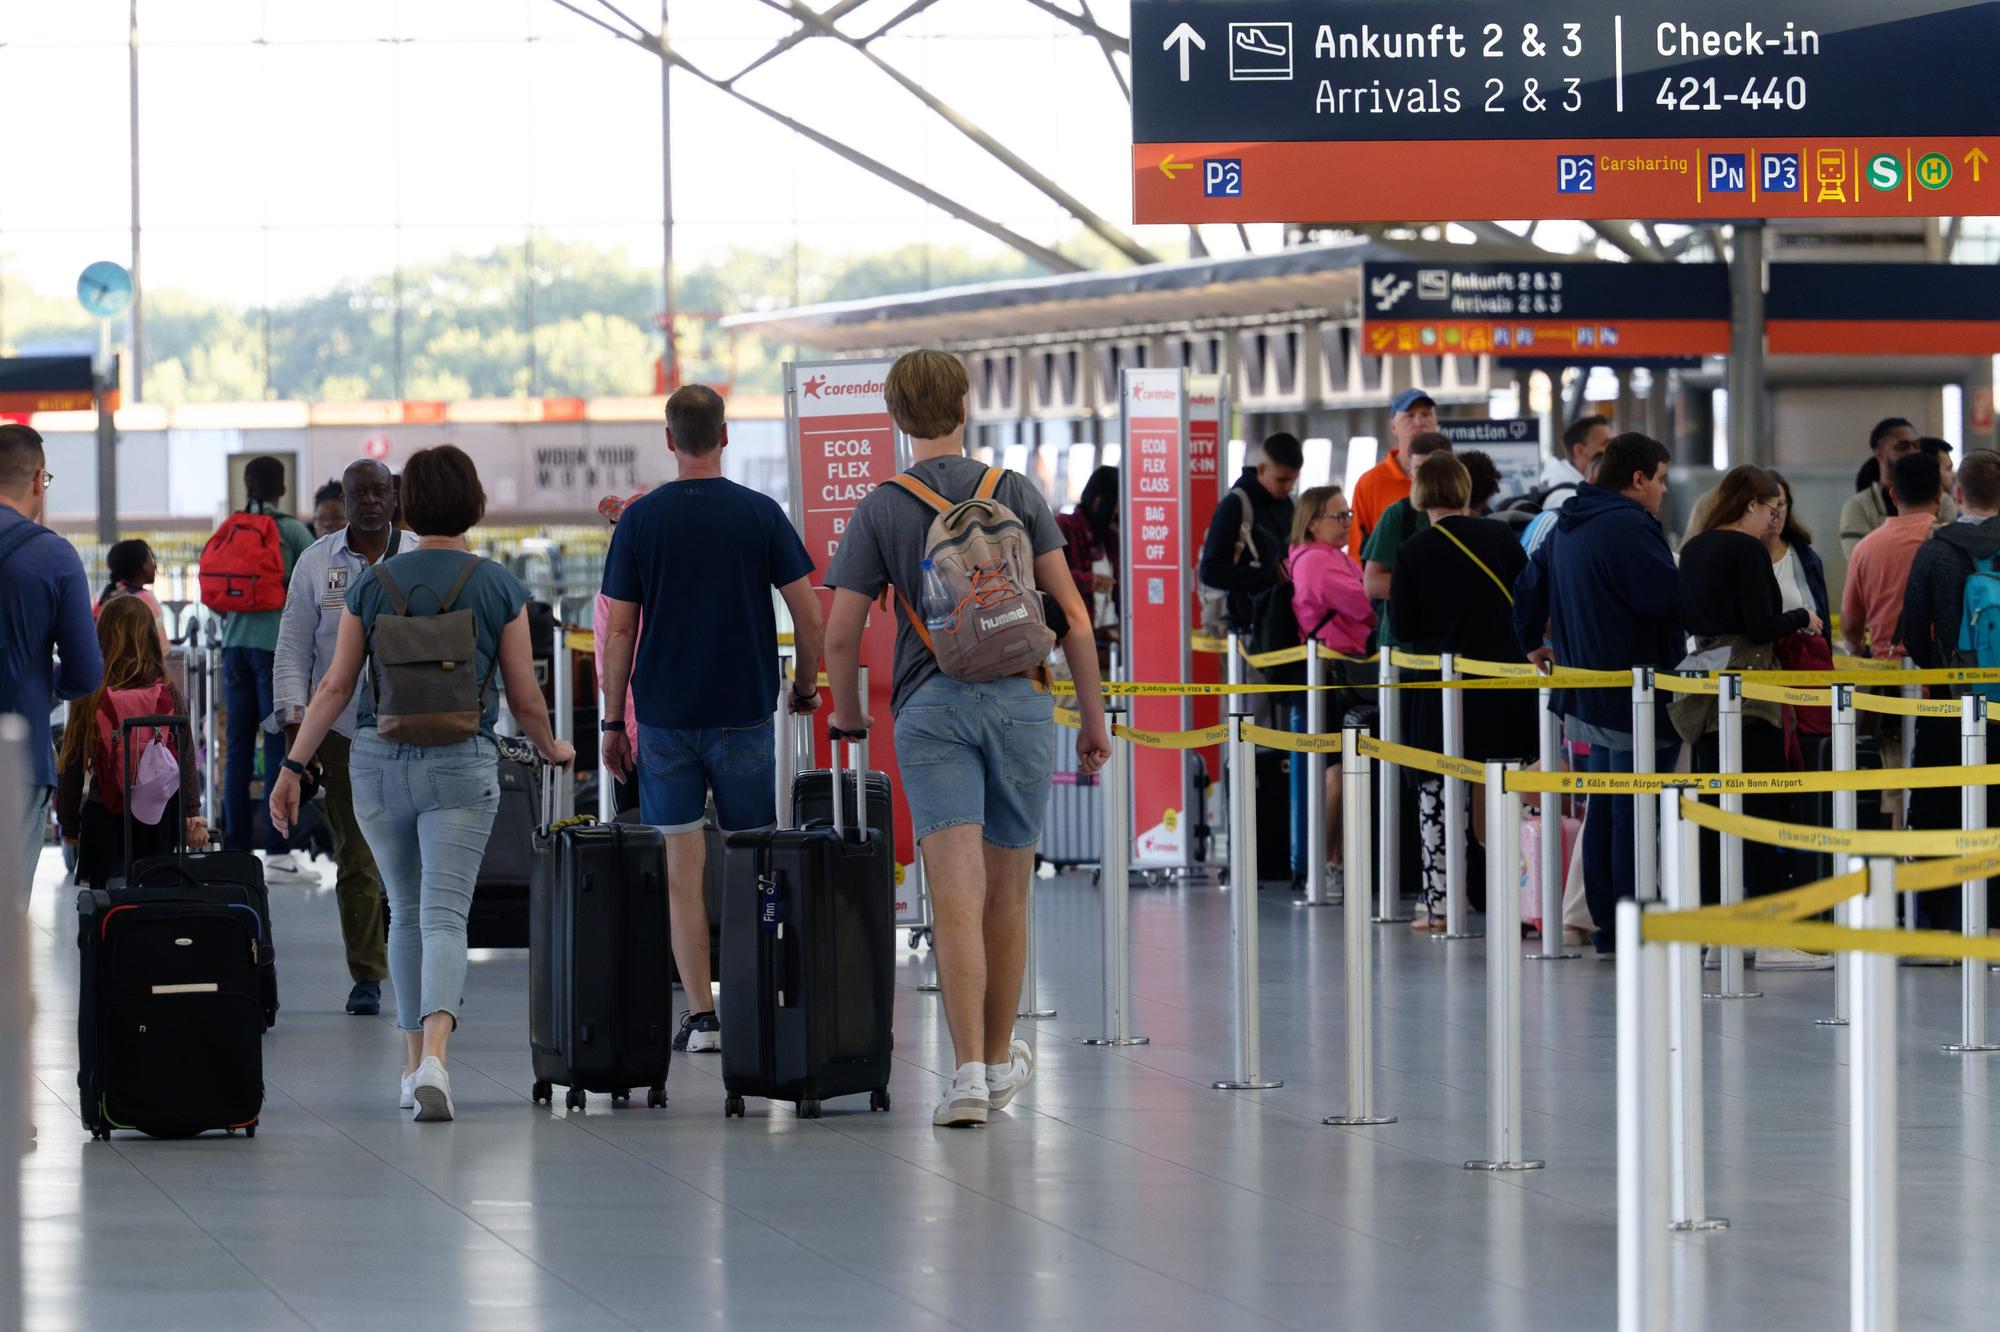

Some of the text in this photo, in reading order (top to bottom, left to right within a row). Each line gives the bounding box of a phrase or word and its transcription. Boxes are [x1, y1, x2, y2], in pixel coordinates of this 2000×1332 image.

[1314, 23, 1582, 59] Ankunft 2 & 3
[1656, 22, 1820, 57] Check-in
[1315, 77, 1582, 114] Arrivals 2 & 3
[1655, 76, 1807, 111] 421-440
[1600, 155, 1688, 174] Carsharing
[1871, 156, 1898, 188] S
[1452, 271, 1516, 291] Ankunft
[1518, 272, 1531, 291] 2
[824, 439, 872, 457] ECO&
[828, 461, 870, 479] FLEX
[1143, 458, 1166, 473] FLEX
[1140, 477, 1170, 493] CLASS
[1145, 506, 1165, 521] BAG
[1142, 526, 1169, 541] DROP
[1146, 545, 1165, 560] OFF
[980, 603, 1029, 631] hummel
[1587, 778, 1607, 788] Köln
[1609, 778, 1630, 788] Bonn
[1725, 778, 1804, 789] Köln Bonn Airport
[763, 902, 776, 922] Finn
